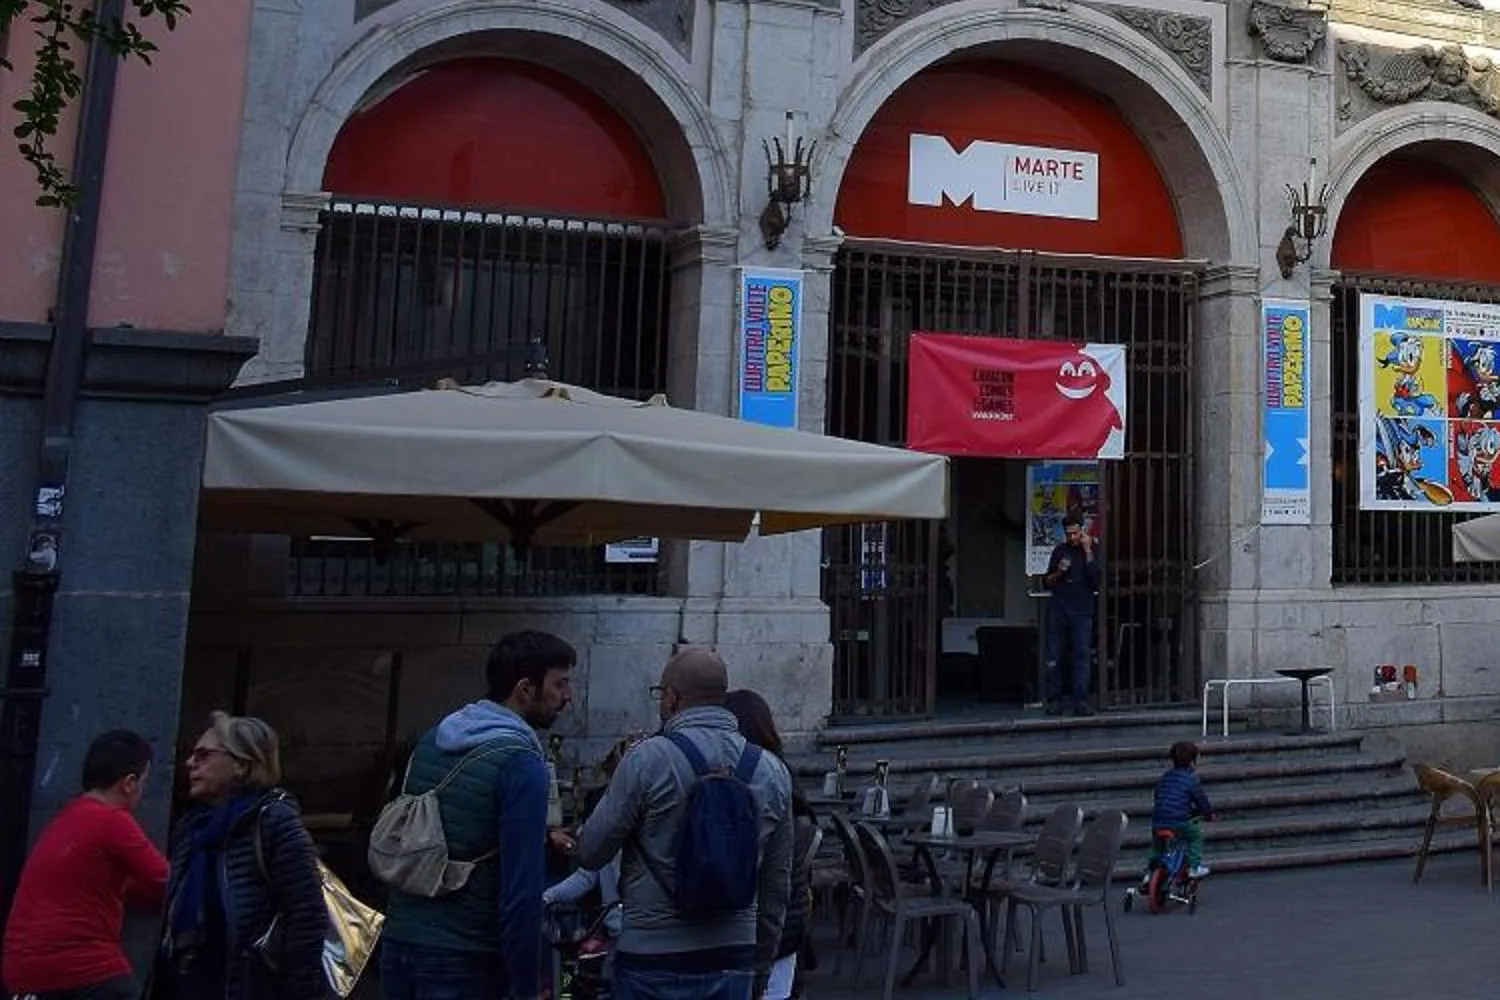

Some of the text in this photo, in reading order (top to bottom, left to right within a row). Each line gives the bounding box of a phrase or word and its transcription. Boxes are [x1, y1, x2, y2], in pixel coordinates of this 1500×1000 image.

[1012, 180, 1045, 194] LIVE
[1014, 156, 1085, 181] MARTE
[766, 284, 794, 393] PAPERINO
[1282, 313, 1304, 409] PAPERINO
